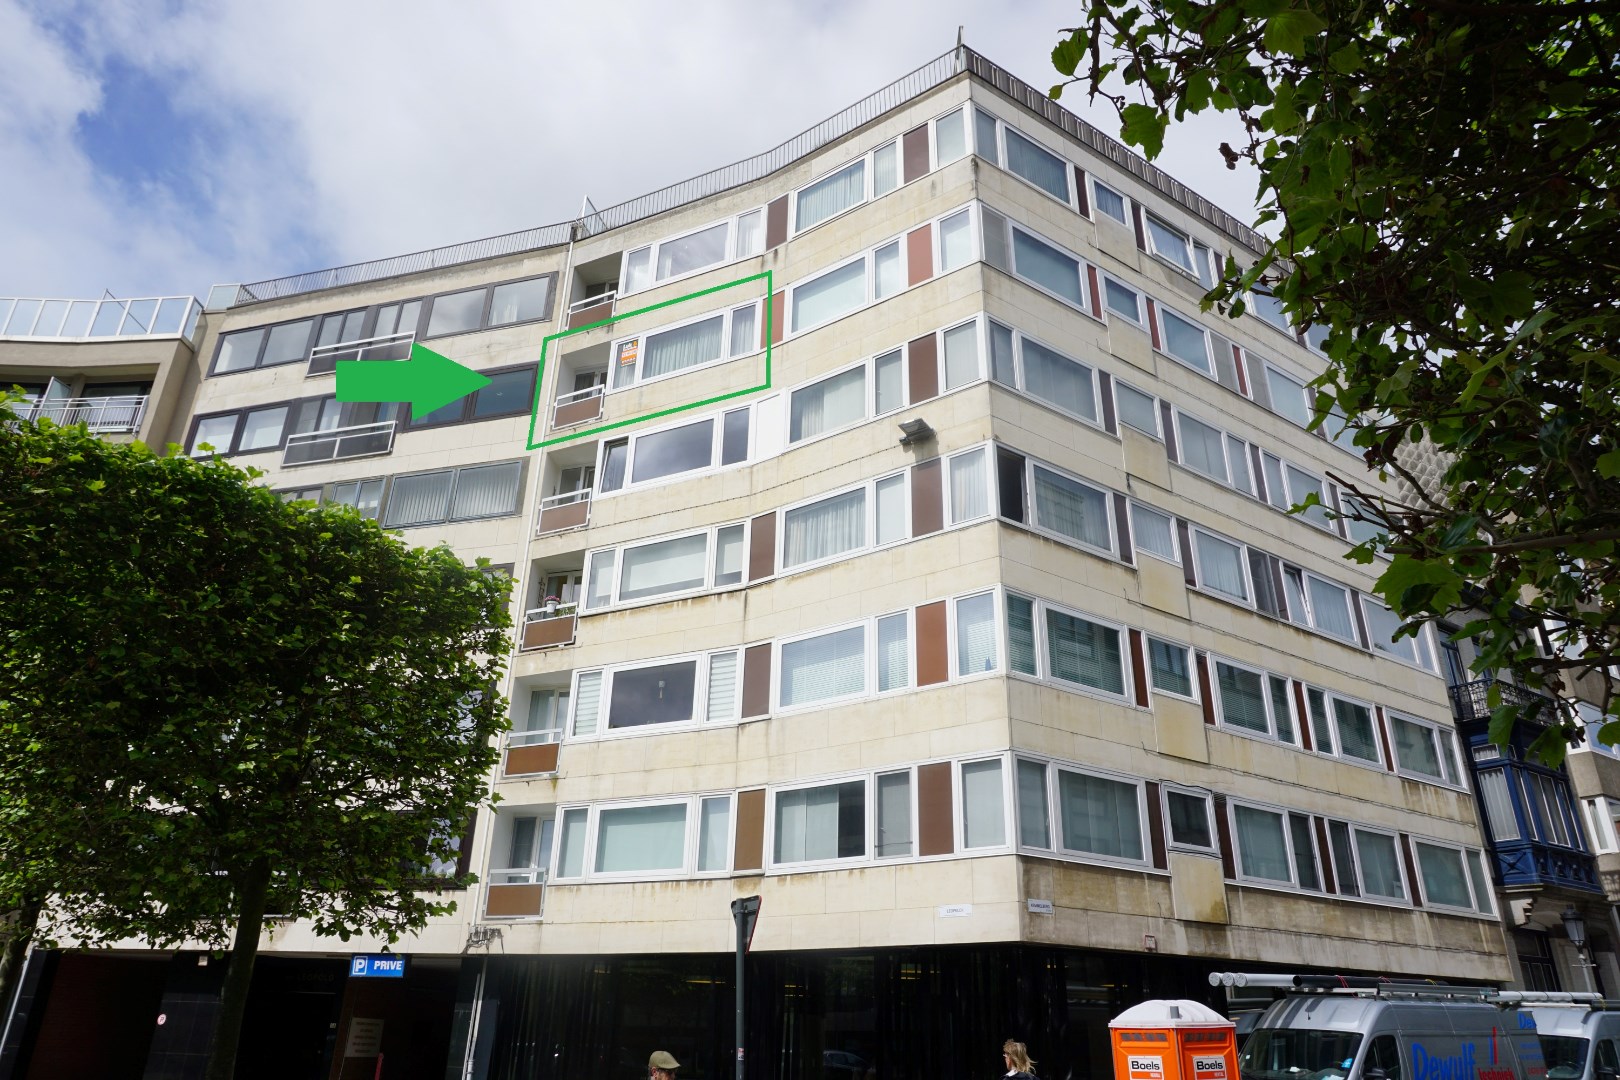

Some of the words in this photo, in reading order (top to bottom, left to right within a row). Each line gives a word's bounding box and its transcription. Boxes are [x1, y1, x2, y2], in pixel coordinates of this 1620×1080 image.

[354, 958, 366, 972] P
[373, 960, 403, 970] PRIVE
[1131, 1061, 1160, 1070] Boels
[1196, 1060, 1223, 1070] Boels
[1412, 1042, 1476, 1080] Dewulf
